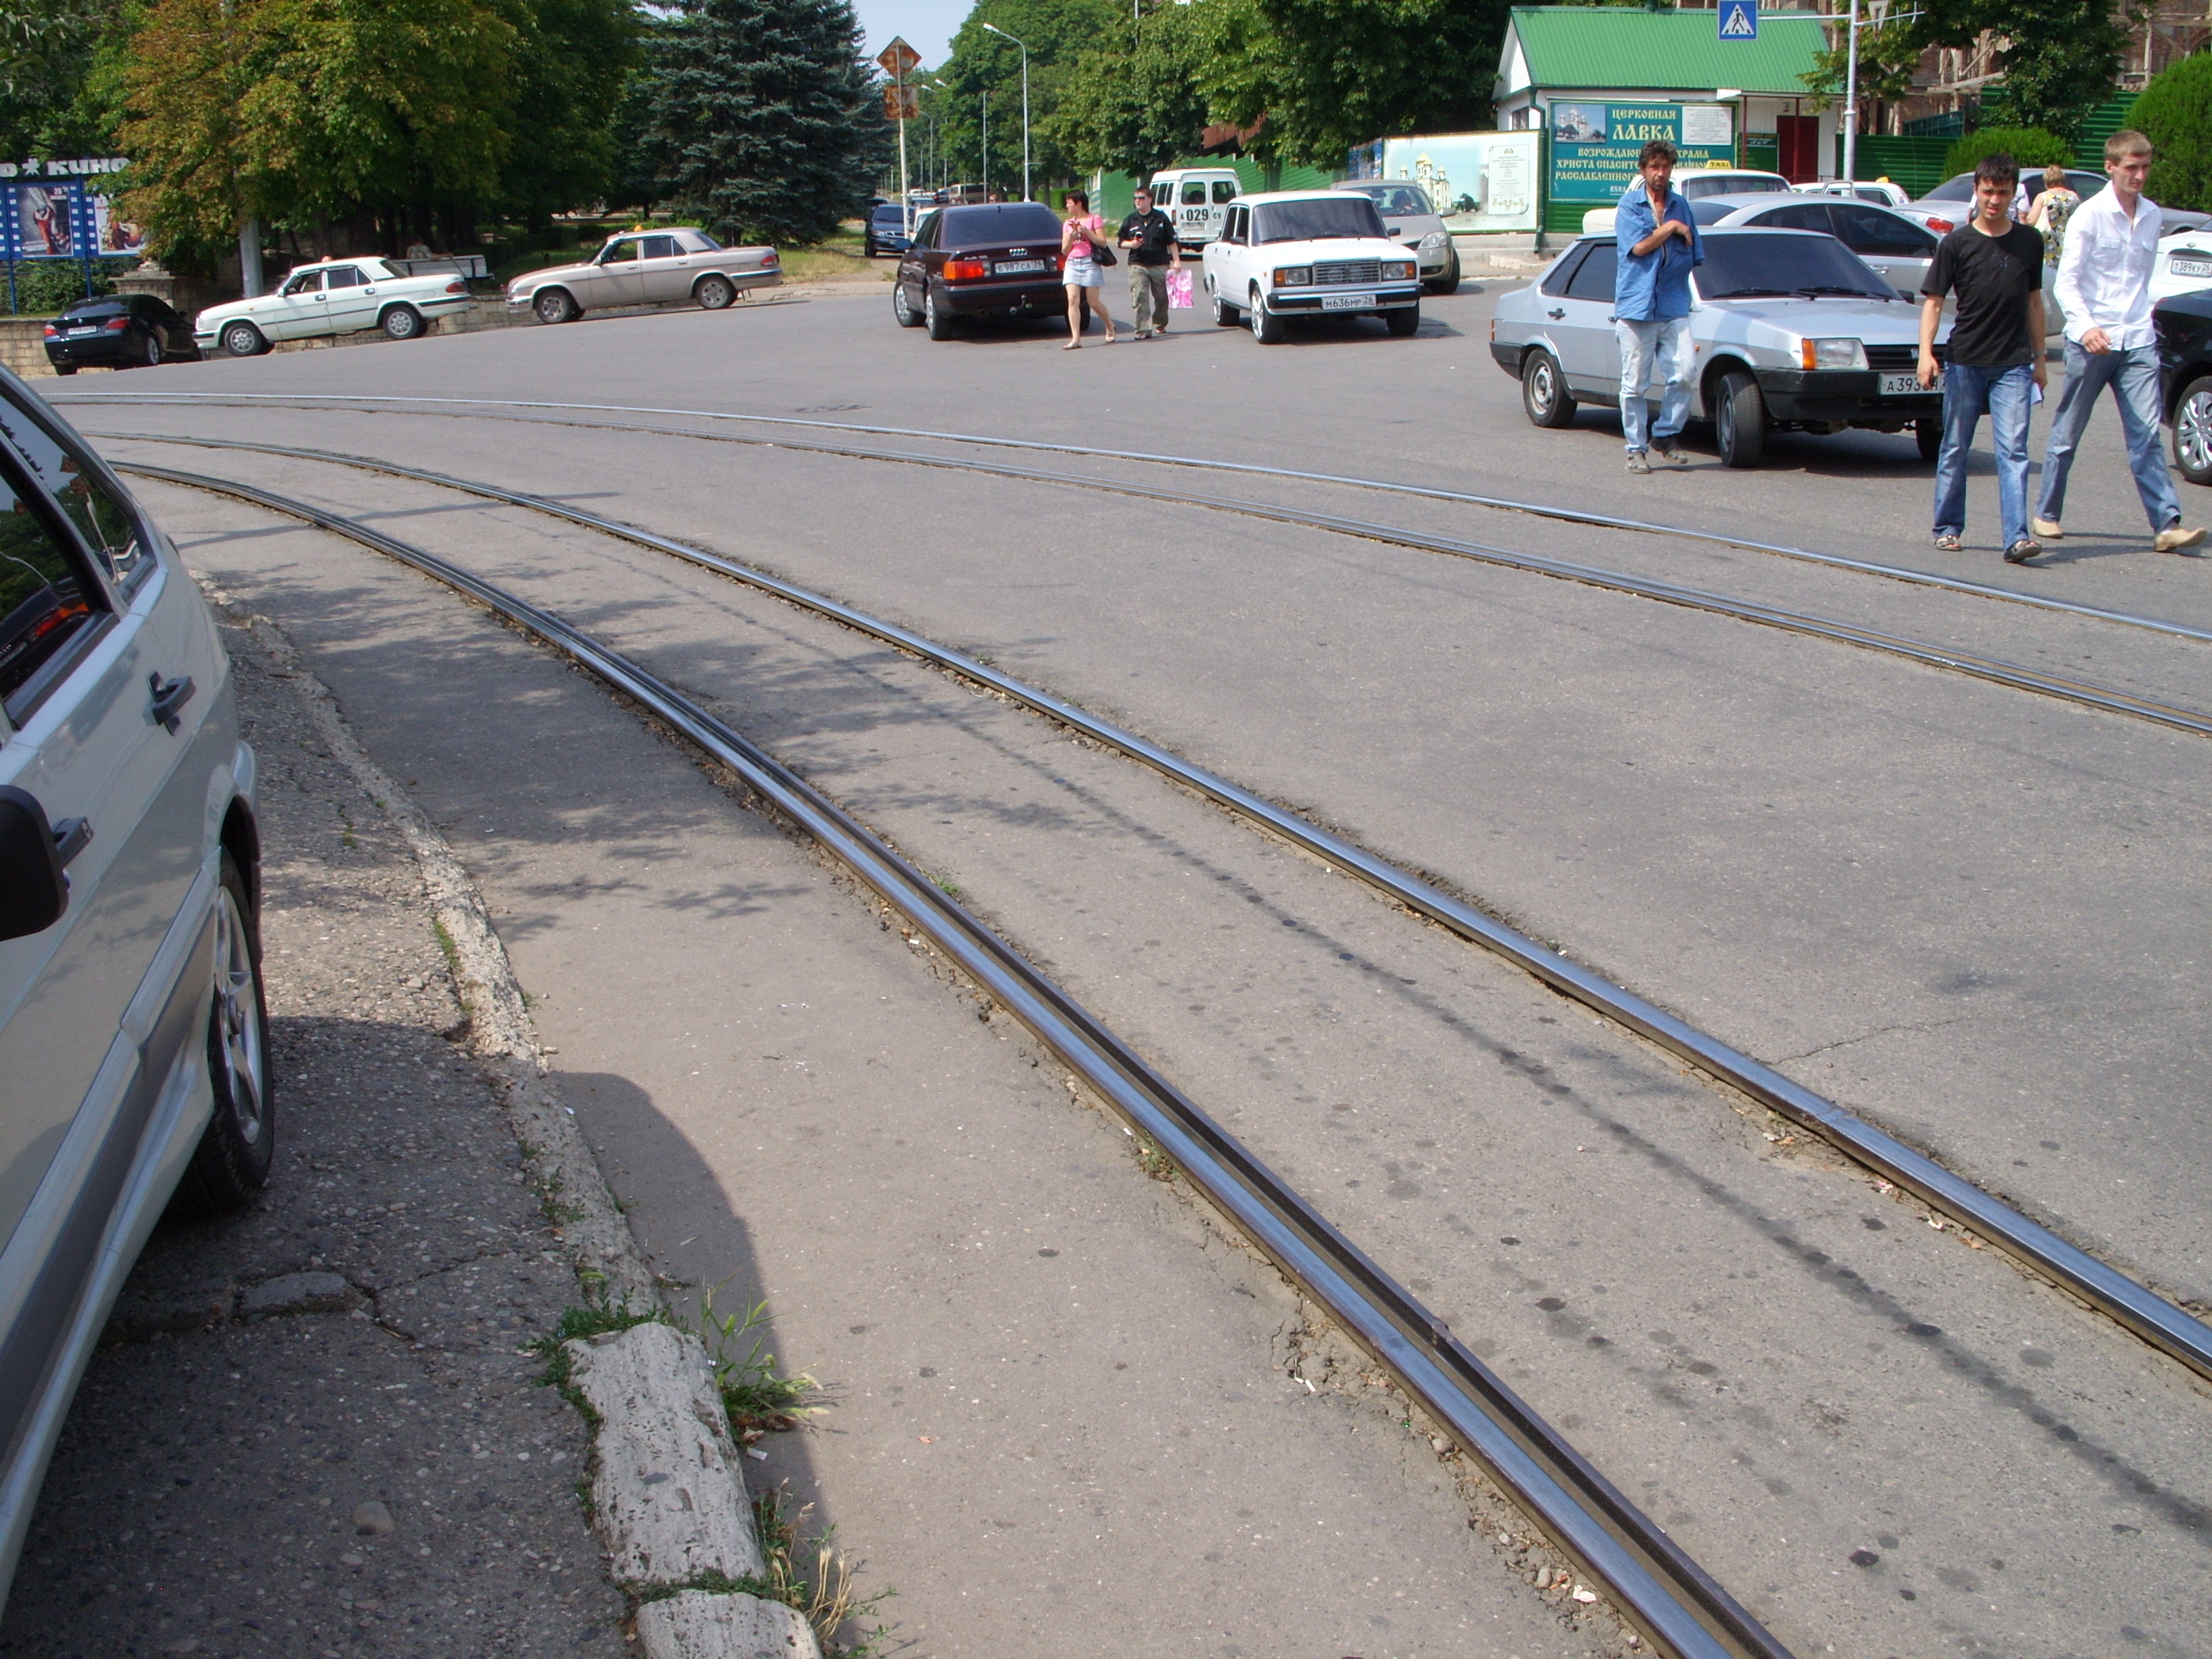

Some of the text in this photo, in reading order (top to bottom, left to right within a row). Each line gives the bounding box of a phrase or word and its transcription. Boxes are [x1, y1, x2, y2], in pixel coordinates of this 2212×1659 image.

[1612, 109, 1676, 120] ЦЕРКОВНАЯ
[1612, 124, 1675, 140] ЛАВКА
[1557, 159, 1594, 169] ХРИСТА
[1186, 208, 1209, 222] 029
[1326, 298, 1361, 308] М636МР
